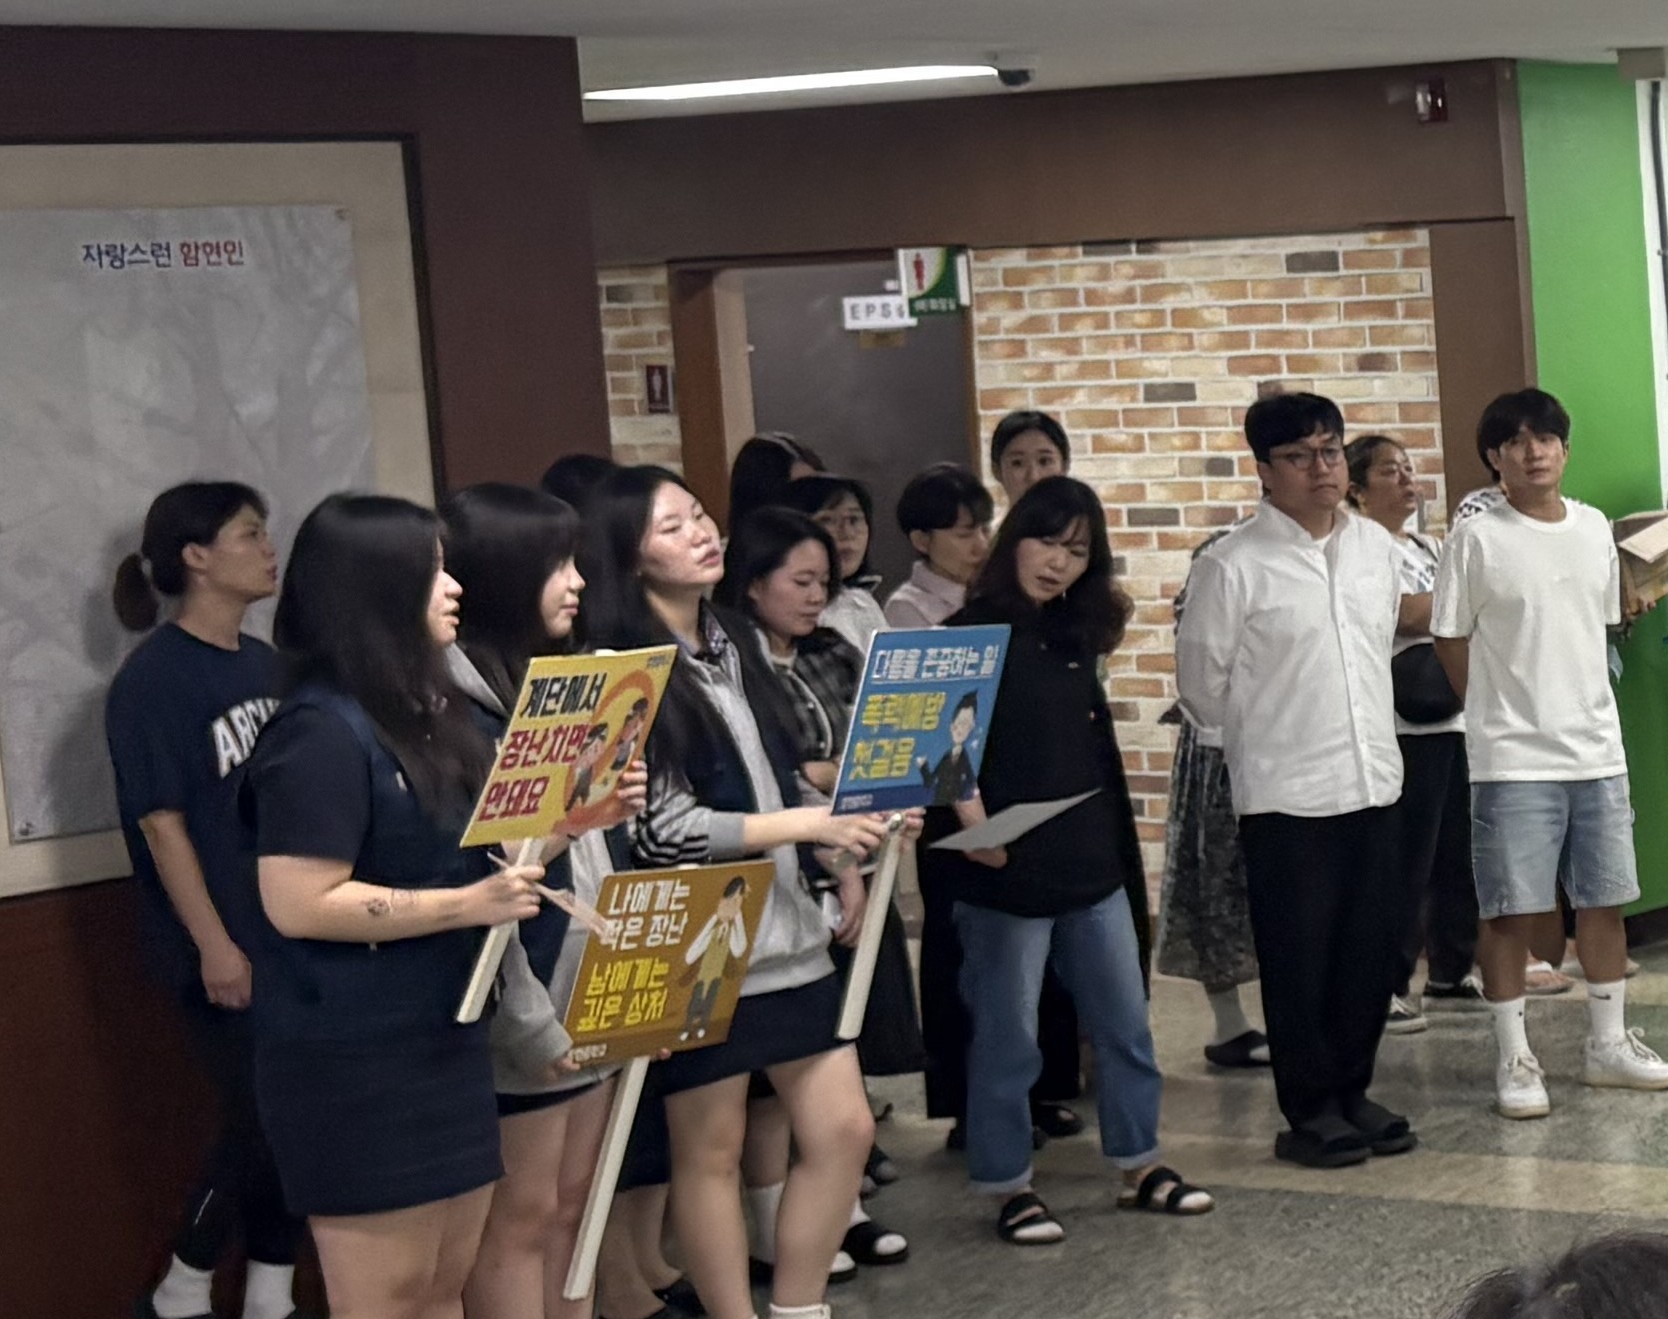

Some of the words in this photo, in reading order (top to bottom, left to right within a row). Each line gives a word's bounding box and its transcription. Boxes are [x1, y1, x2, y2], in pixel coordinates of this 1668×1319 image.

[82, 242, 172, 270] 자랑스런
[520, 672, 608, 718] 계단에서
[608, 878, 691, 916] 나에게는
[645, 911, 689, 948] 장난
[585, 956, 670, 997] 남에게는
[576, 995, 622, 1033] 깊은
[623, 987, 669, 1027] 상처
